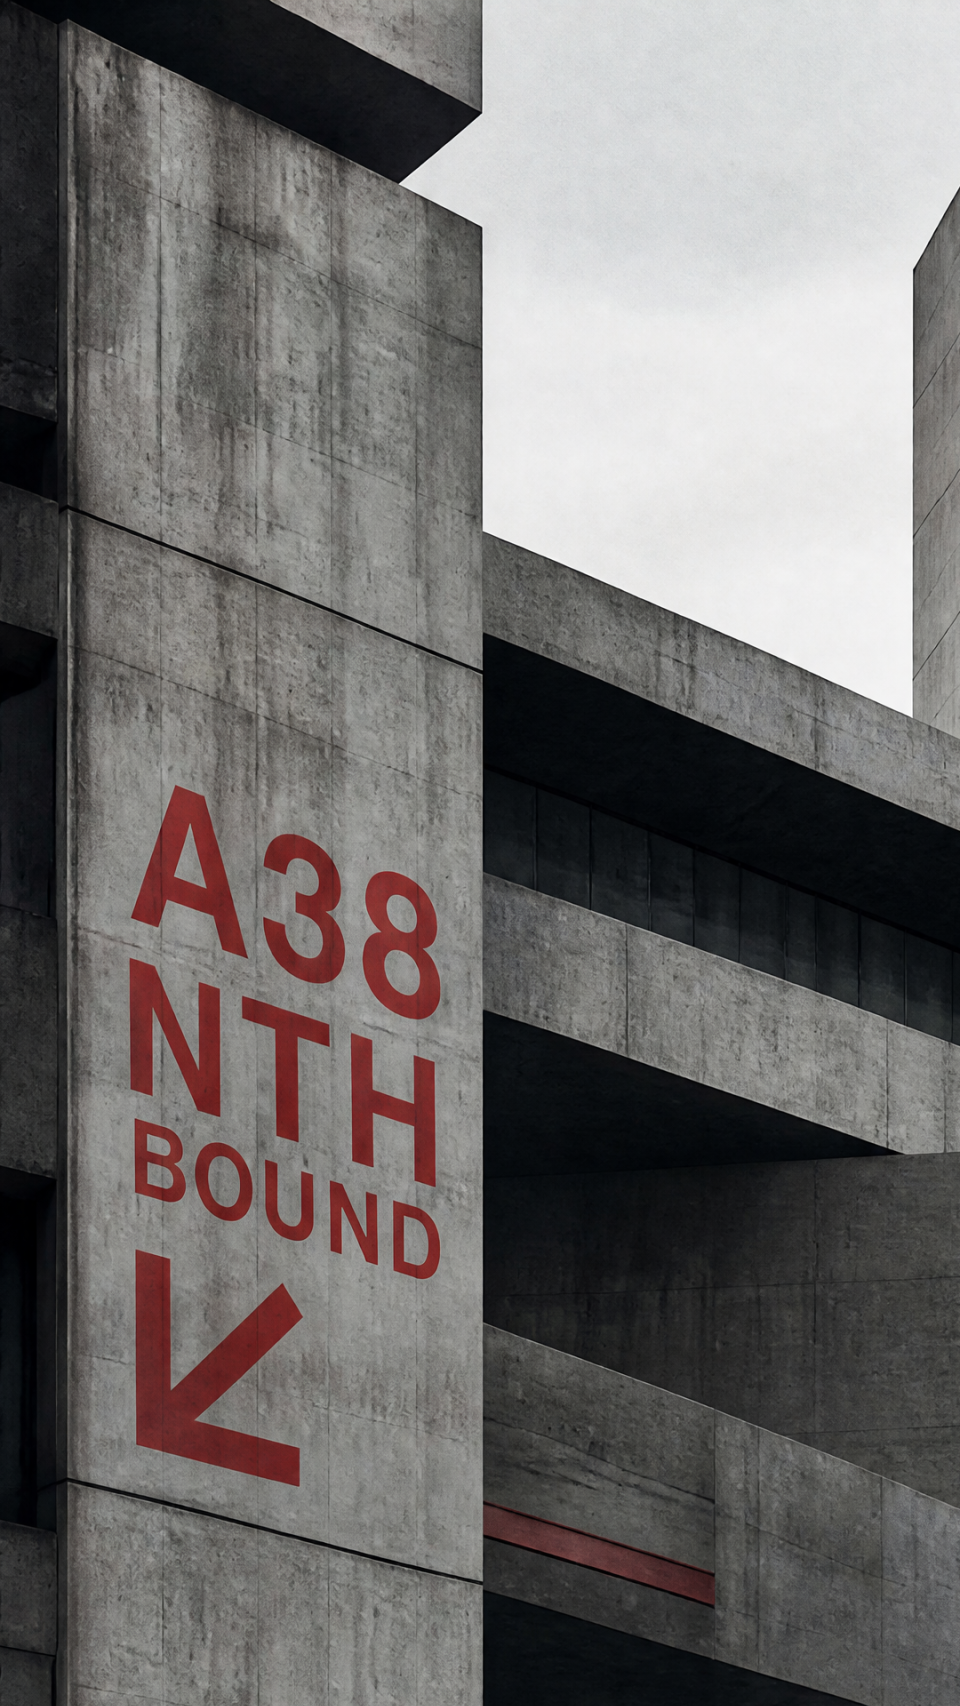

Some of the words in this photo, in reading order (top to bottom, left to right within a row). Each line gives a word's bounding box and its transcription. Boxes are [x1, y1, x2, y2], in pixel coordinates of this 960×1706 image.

[131, 785, 441, 1020] A38
[129, 957, 437, 1188] NTH
[134, 1118, 441, 1280] BOUND
